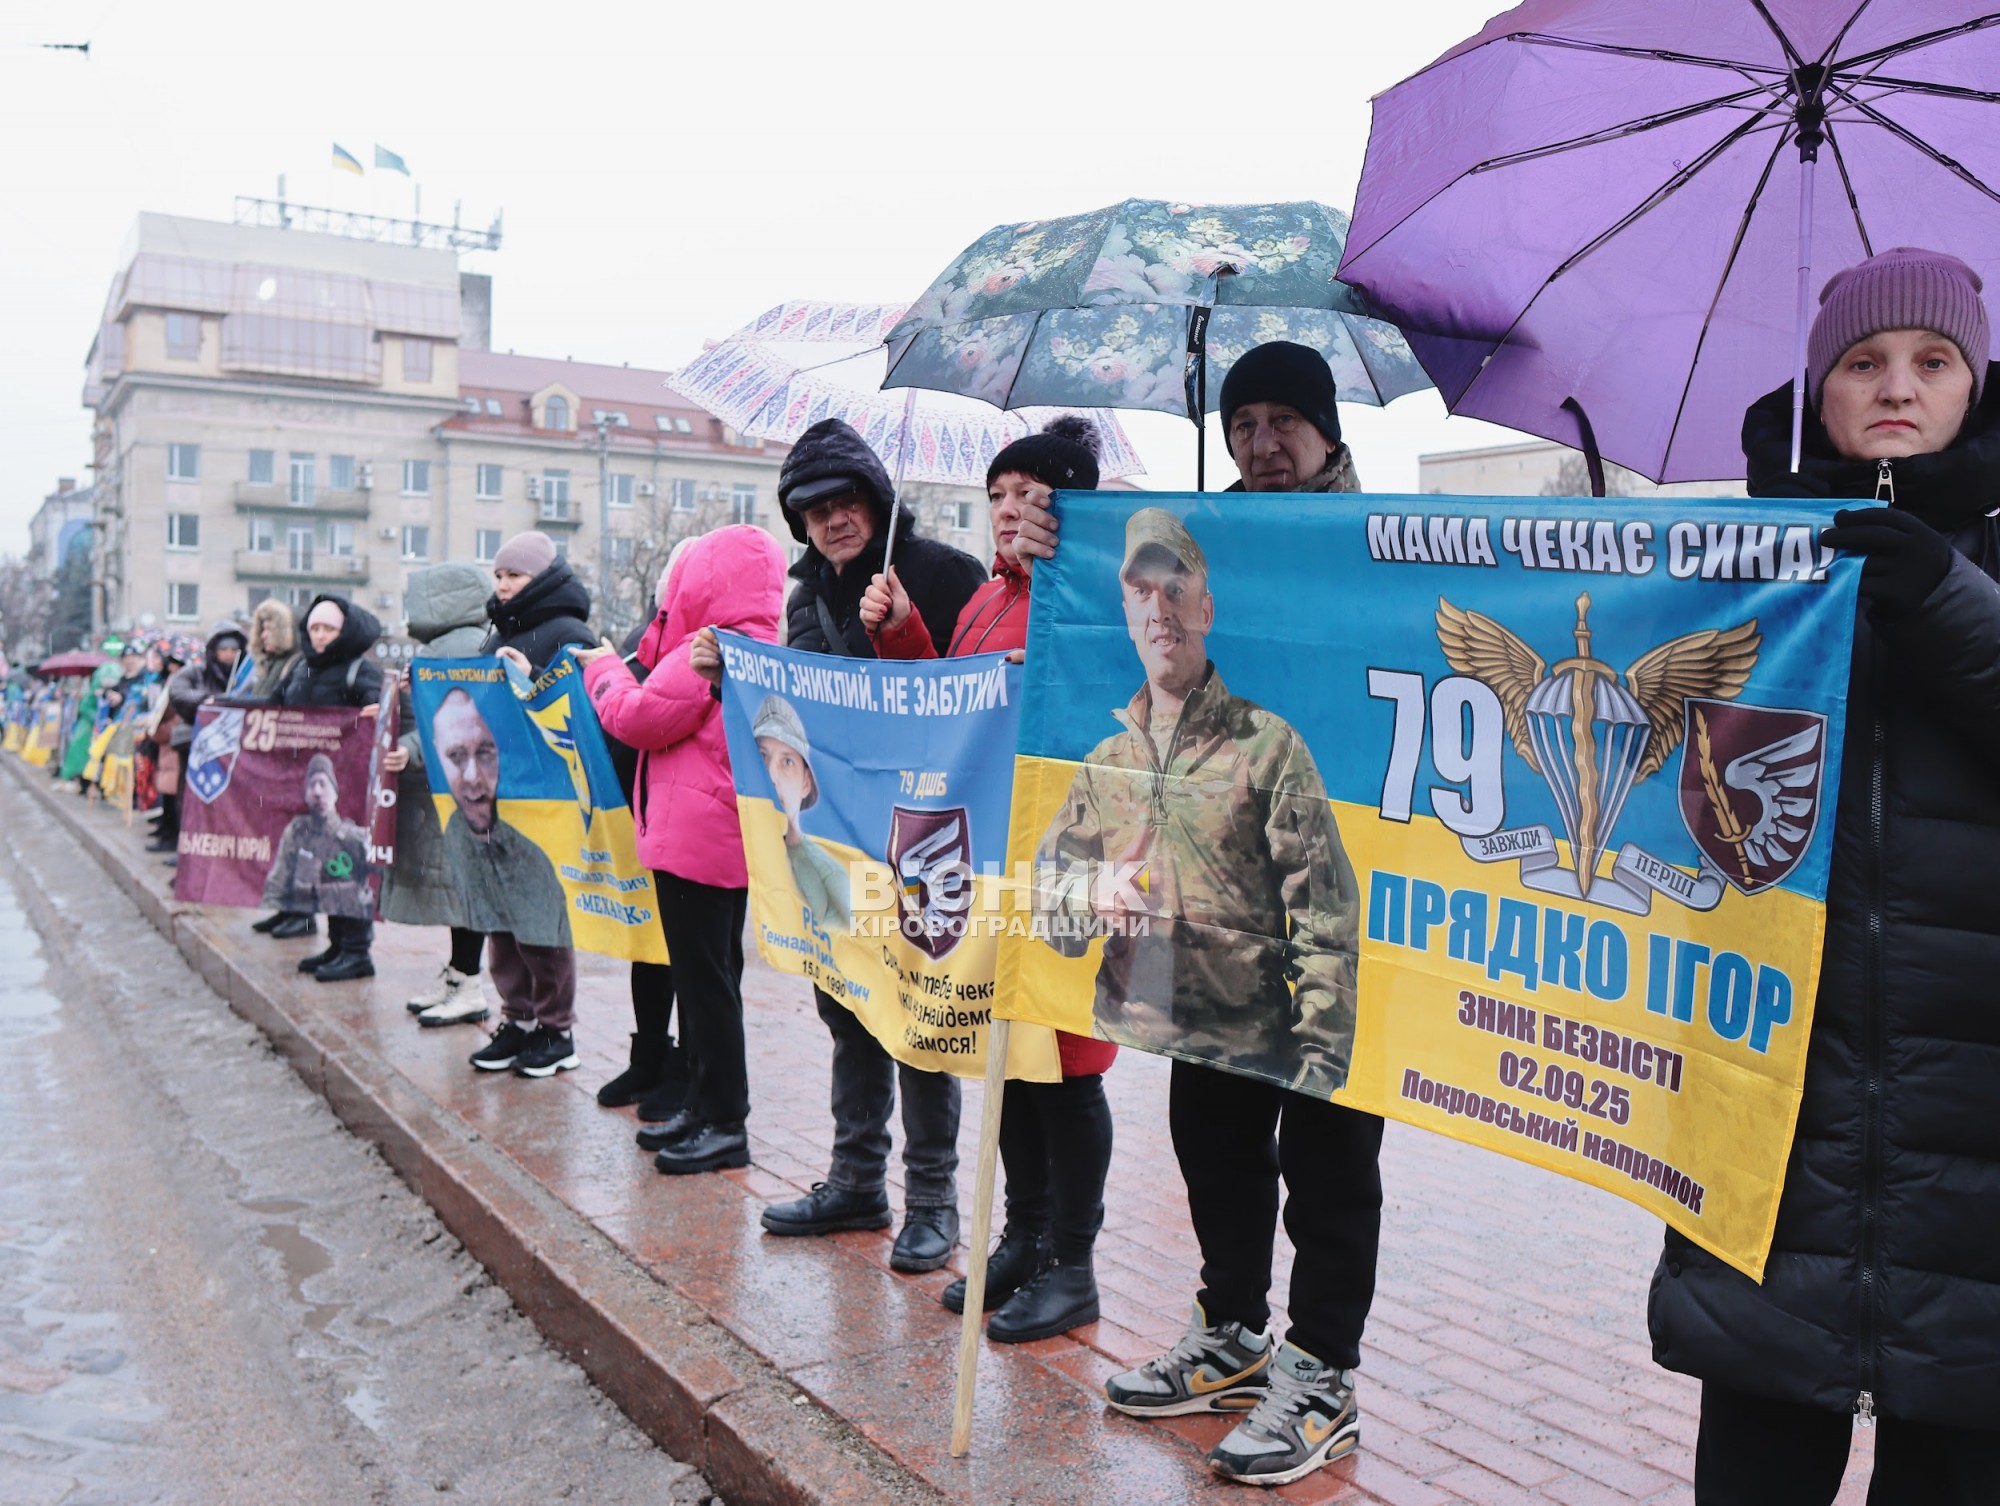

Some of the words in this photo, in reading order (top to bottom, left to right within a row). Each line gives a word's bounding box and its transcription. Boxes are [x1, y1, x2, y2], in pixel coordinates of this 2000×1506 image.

[1367, 514, 1496, 566] МАМА
[1502, 518, 1655, 576] ЧЕКАЄ
[1667, 522, 1835, 582] СИНА!
[720, 641, 786, 694] ЕЗВІСТІ
[788, 663, 879, 712] ЗНИКЛИЙ.
[881, 675, 909, 715] НЕ
[913, 658, 1008, 716] ЗАБУТИЙ
[242, 709, 279, 752] 25
[1366, 666, 1504, 839] 79
[899, 770, 914, 795] 79
[913, 772, 948, 800] ДШБ
[1478, 829, 1543, 856] ЗАВЖДИ
[1634, 853, 1696, 899] ПЕРШІ
[1367, 870, 1629, 1002] ПРЯДКО
[1647, 933, 1793, 1054] ІГОР
[1457, 990, 1537, 1045] ЗНИК
[1542, 1014, 1683, 1094] БЕЗВІСТІ
[1498, 1050, 1631, 1126] 02.09.25
[1401, 1068, 1578, 1153] Покровський
[1582, 1132, 1705, 1215] напрямок
